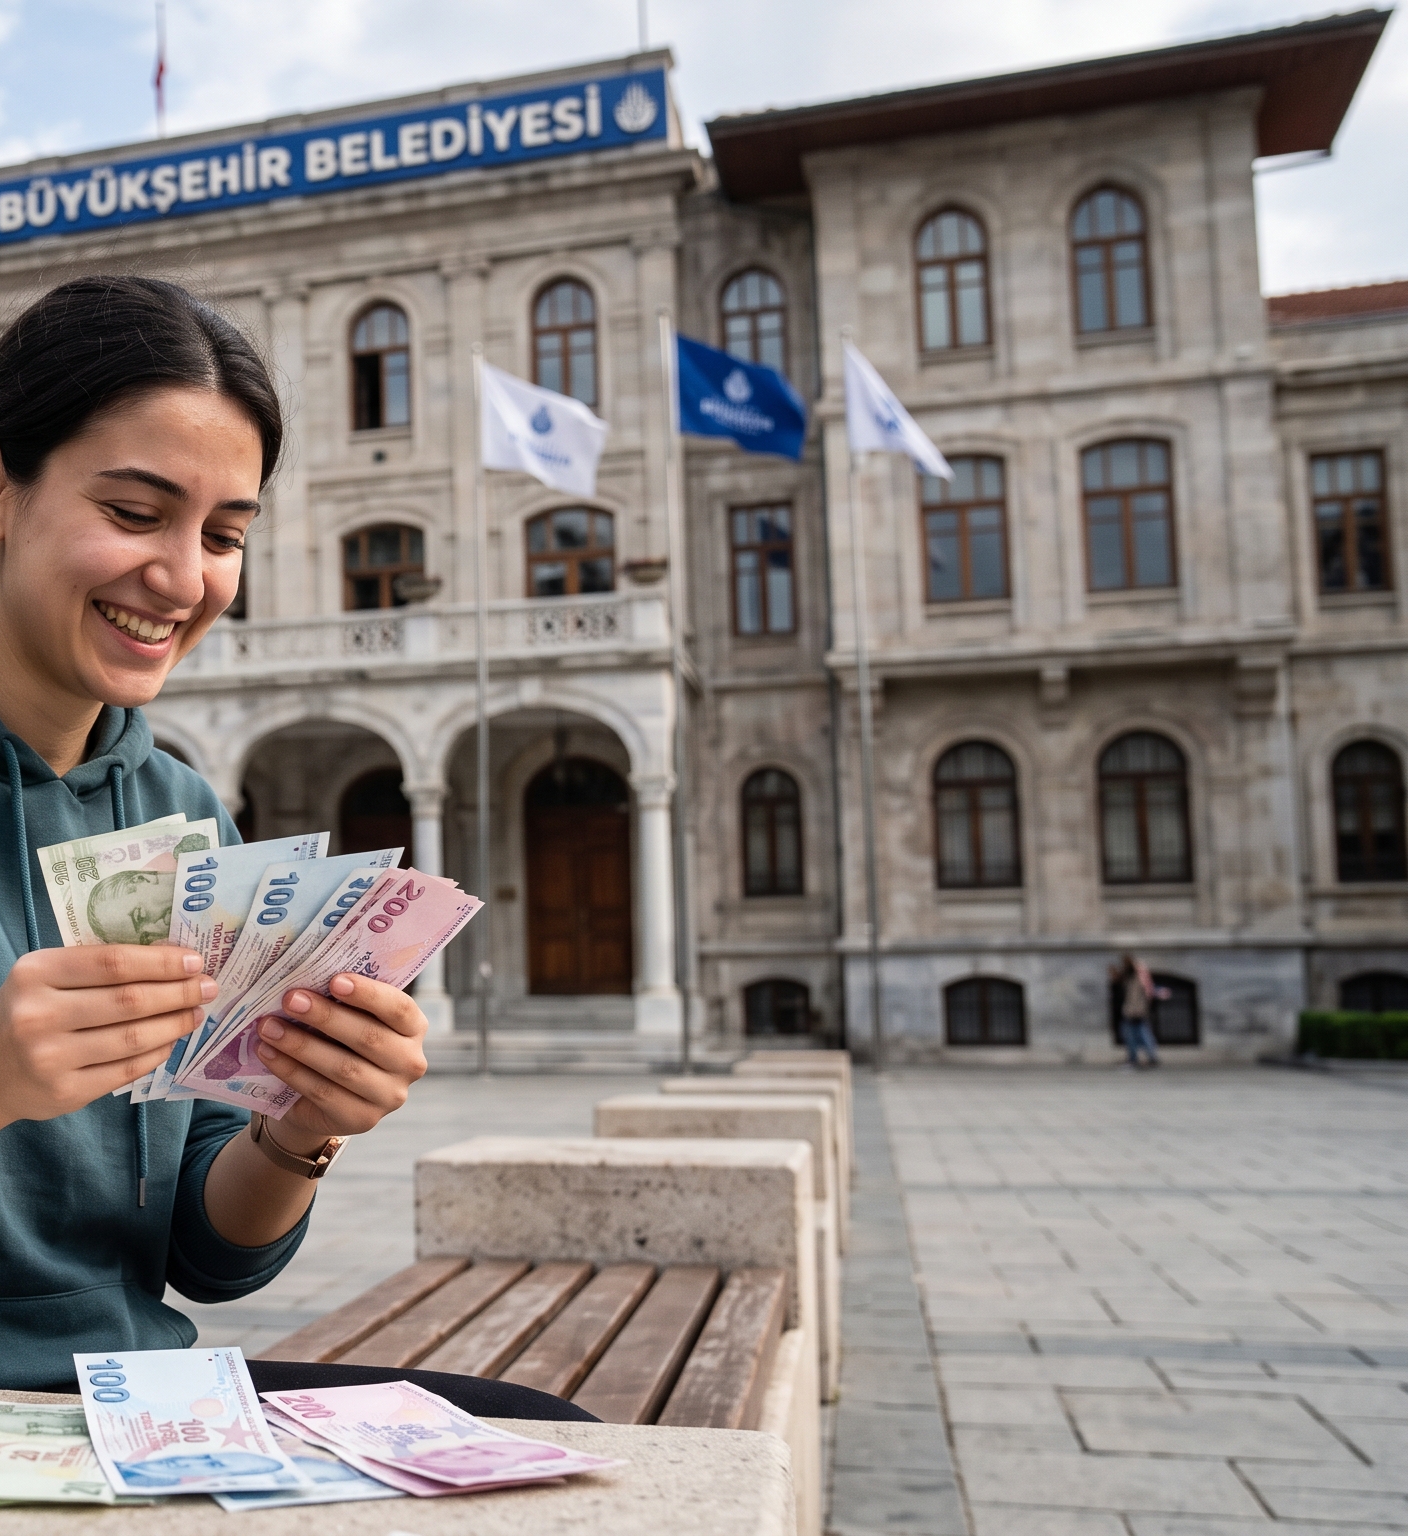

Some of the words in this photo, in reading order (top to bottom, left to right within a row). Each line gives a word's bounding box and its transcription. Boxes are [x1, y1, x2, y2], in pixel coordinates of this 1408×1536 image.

[305, 83, 602, 182] BELEDİYESİ
[183, 857, 219, 912] 100
[257, 871, 300, 926] 100
[367, 879, 425, 934] 200
[87, 1359, 130, 1403] 100
[277, 1395, 336, 1419] 200
[179, 1418, 210, 1443] 100
